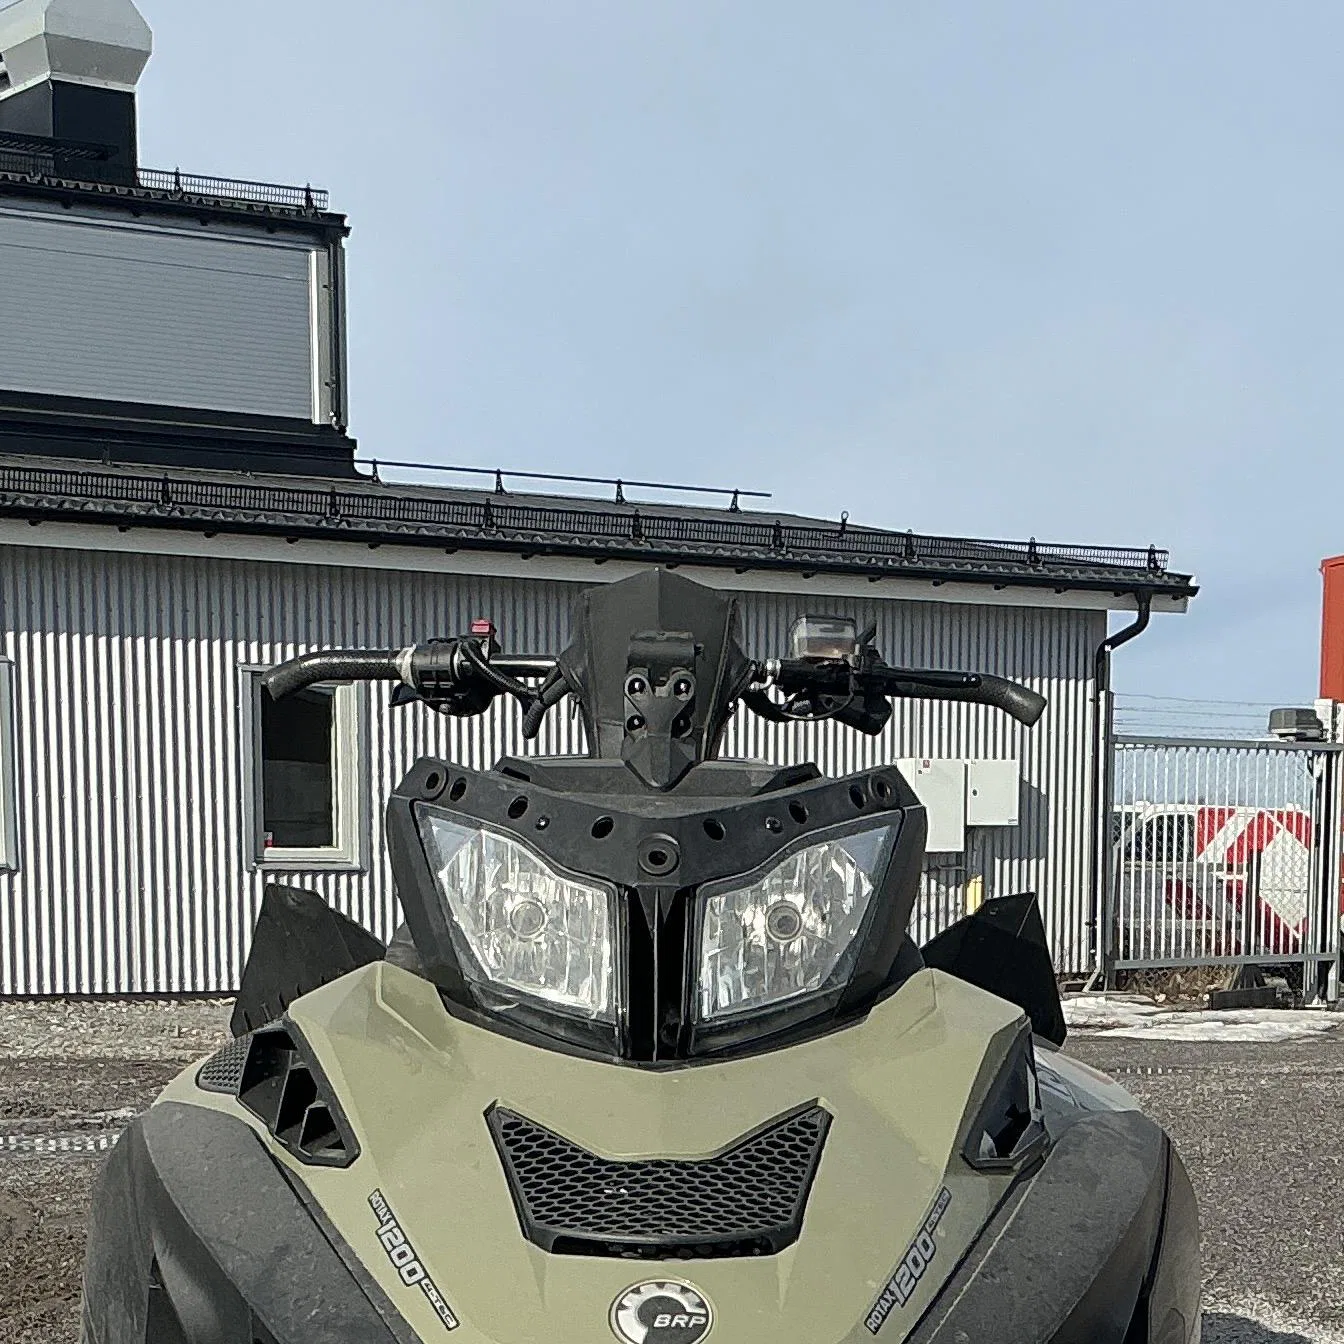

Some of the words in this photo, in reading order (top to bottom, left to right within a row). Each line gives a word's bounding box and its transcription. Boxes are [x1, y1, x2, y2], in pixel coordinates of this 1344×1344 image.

[370, 1189, 394, 1226] ROTAX
[377, 1220, 426, 1285] 1200
[866, 1289, 897, 1332] ROTAX
[889, 1230, 936, 1306] 1200
[653, 1313, 707, 1328] BRP
